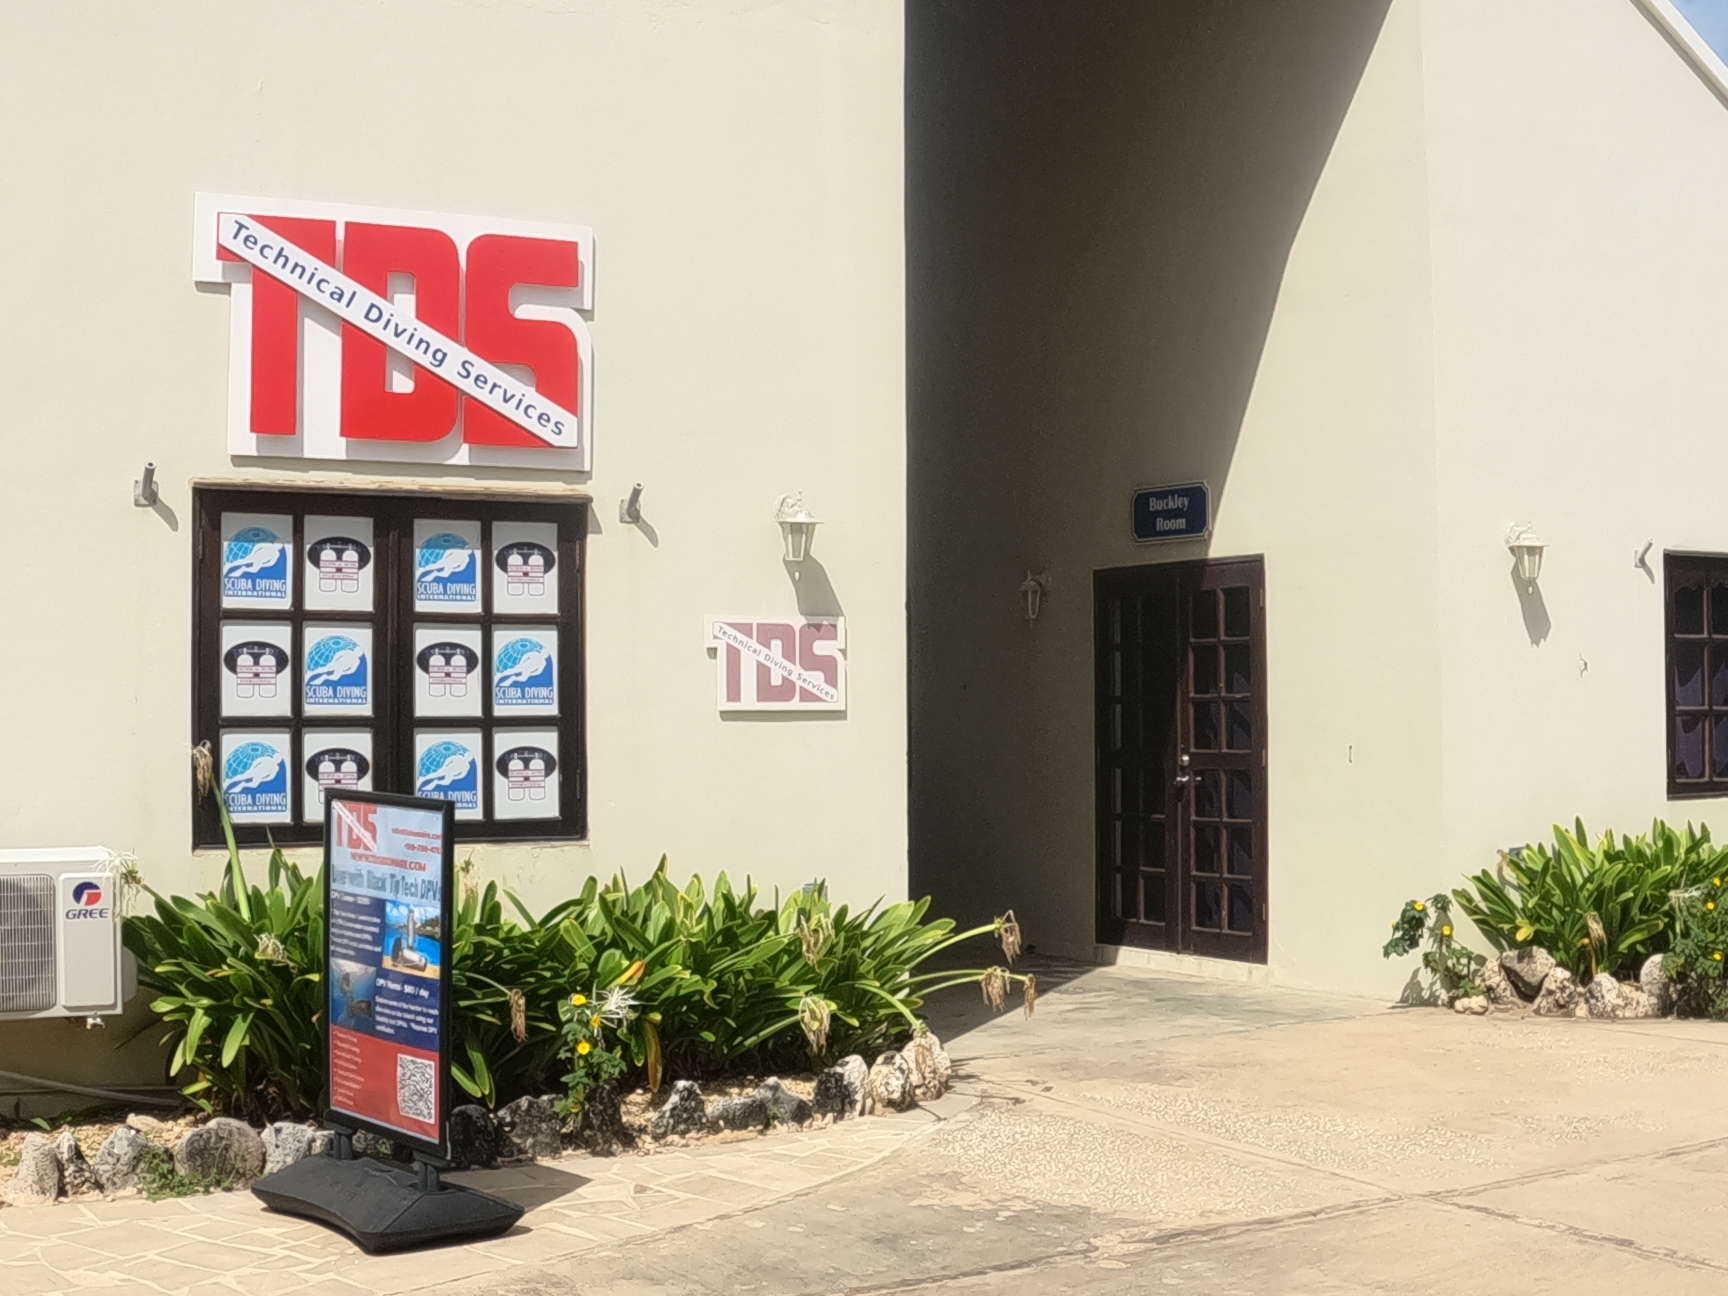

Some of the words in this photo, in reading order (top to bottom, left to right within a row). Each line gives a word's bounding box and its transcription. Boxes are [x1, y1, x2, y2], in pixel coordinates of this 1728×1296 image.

[216, 212, 579, 448] TDS
[231, 219, 357, 308] Technical
[363, 302, 448, 368] Diving
[457, 359, 565, 437] Services
[1149, 494, 1190, 511] Buckley
[1156, 517, 1186, 531] Room
[224, 578, 252, 590] SCUBA
[256, 579, 286, 591] DIVING
[417, 582, 444, 594] SCUBA
[447, 583, 476, 595] DIVING
[713, 622, 838, 703] TDS
[718, 625, 762, 656] Technical
[764, 654, 794, 676] Diving
[796, 673, 835, 700] Services
[306, 686, 334, 698] SCUBA
[337, 686, 366, 698] DIVING
[496, 687, 522, 698] SCUBA
[525, 687, 553, 698] DIVING
[256, 793, 286, 805] DIVING
[448, 790, 476, 802] DIVING
[65, 908, 110, 920] GREE
